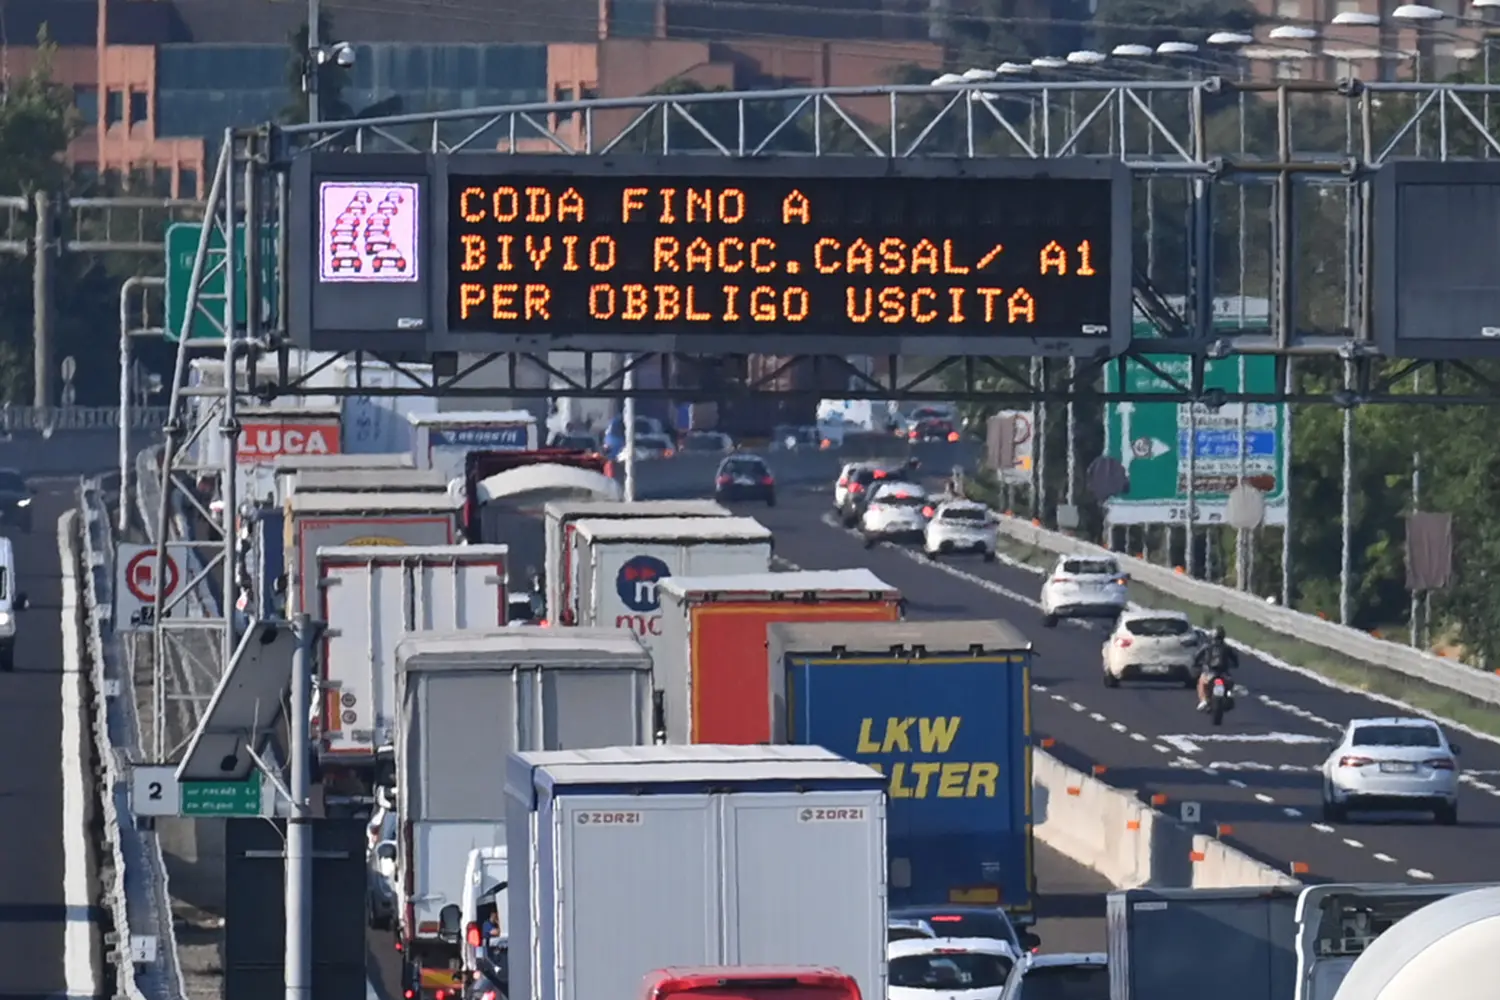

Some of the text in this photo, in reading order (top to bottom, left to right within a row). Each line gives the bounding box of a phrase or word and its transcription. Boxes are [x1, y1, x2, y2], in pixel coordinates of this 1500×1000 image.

[460, 187, 810, 225] CODA FINO A
[461, 235, 1096, 276] BIVIO RACC.CASAL/ A1
[460, 284, 1035, 324] PER OBBLIGO USCITA
[241, 431, 327, 453] LUCA
[856, 716, 962, 754] LKW
[148, 782, 163, 800] 2
[870, 762, 1000, 799] LTER
[593, 813, 640, 824] ZORZI
[815, 809, 864, 820] ZORZI
